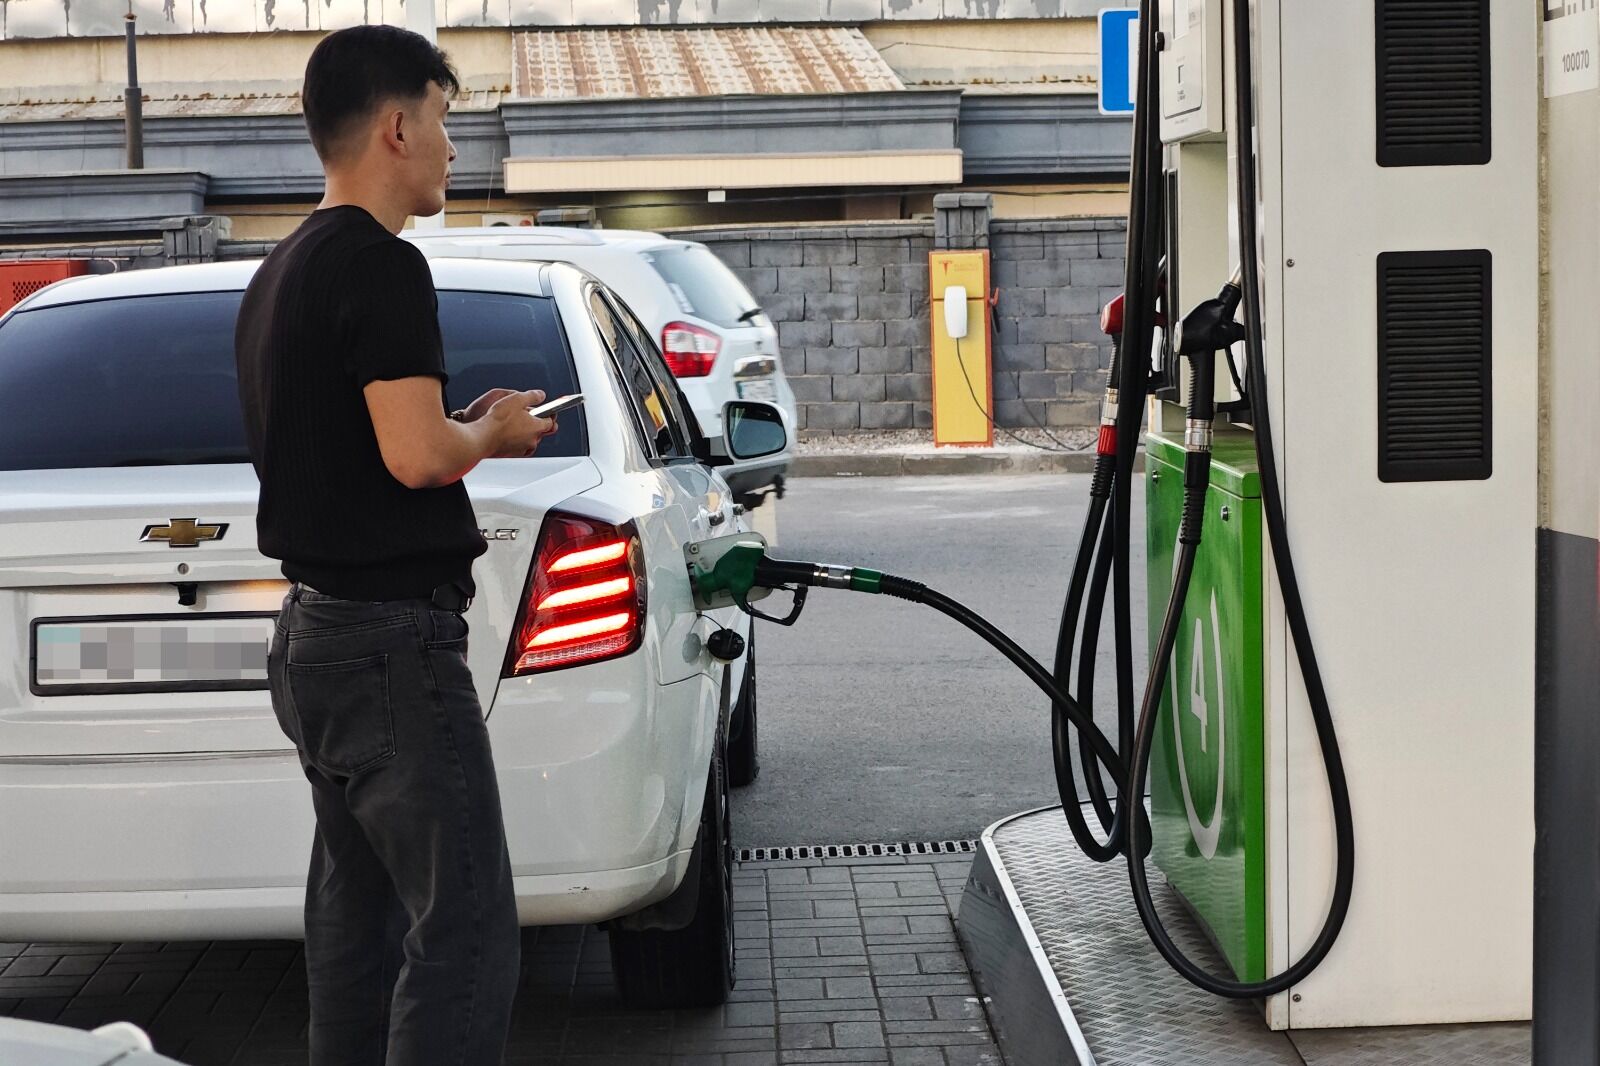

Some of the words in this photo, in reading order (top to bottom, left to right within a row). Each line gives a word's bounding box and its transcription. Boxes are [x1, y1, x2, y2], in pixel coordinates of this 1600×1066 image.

[1562, 49, 1590, 73] 100070
[479, 528, 520, 541] LET
[1190, 617, 1208, 754] 4
